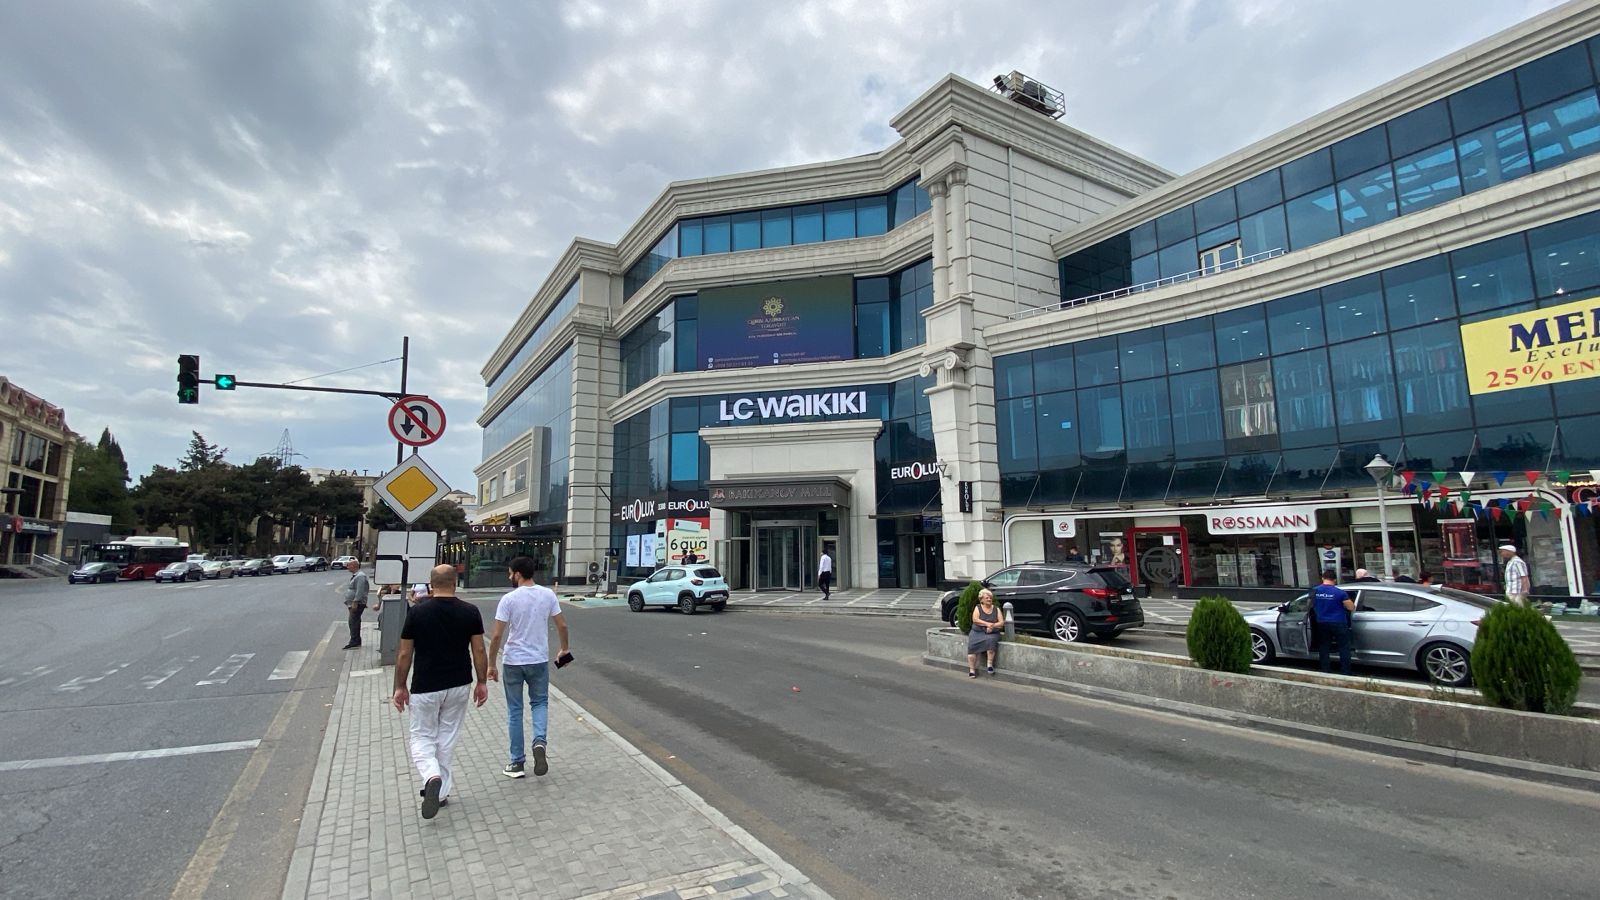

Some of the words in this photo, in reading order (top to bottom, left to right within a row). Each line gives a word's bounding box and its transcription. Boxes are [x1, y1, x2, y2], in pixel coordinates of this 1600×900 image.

[1486, 362, 1553, 388] 25%
[1563, 359, 1600, 376] EN
[719, 398, 754, 421] LC
[800, 486, 832, 497] MALL
[621, 498, 655, 523] EUROLUX
[1212, 514, 1309, 530] ROSSMANN
[670, 538, 679, 550] 6
